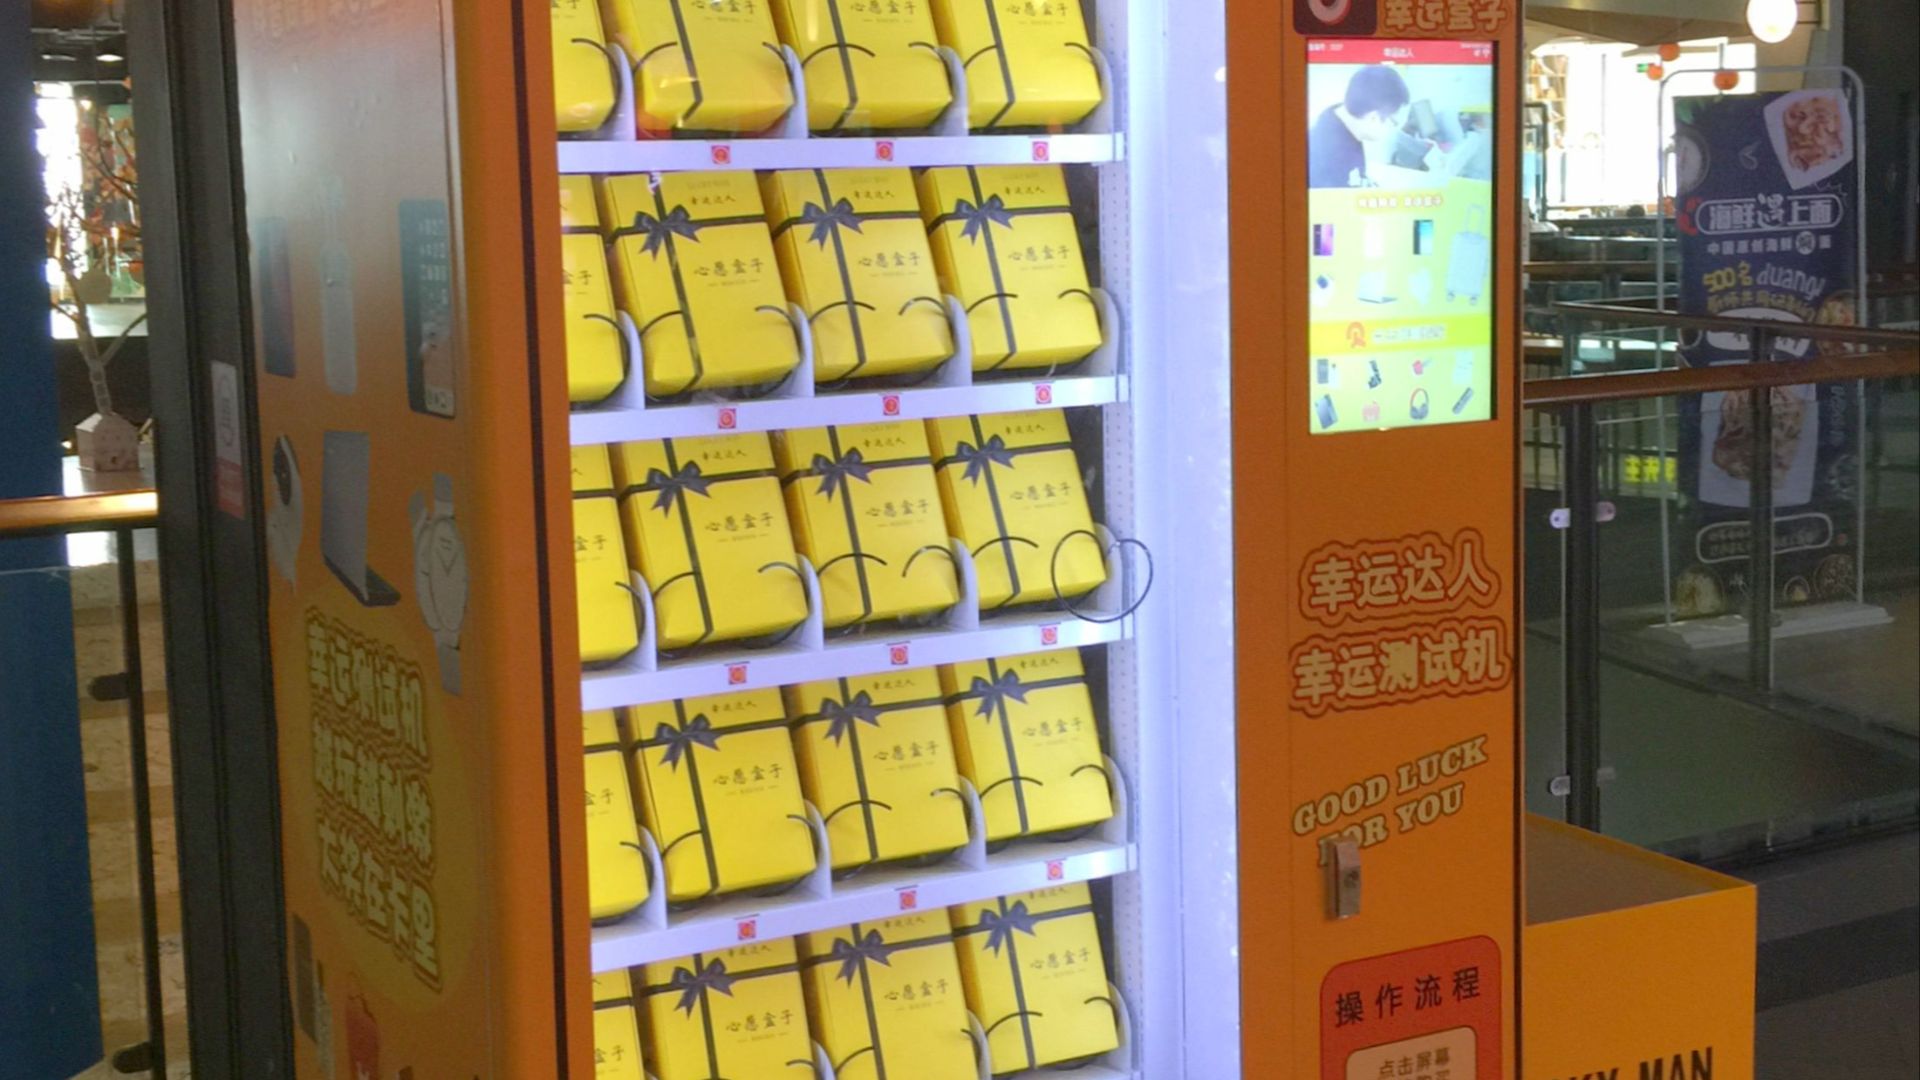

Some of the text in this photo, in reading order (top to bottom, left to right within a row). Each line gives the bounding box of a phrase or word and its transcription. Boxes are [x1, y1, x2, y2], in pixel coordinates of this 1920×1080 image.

[1385, 0, 1506, 30] 幸运盒子
[1309, 541, 1490, 614] 幸运达人
[1294, 628, 1503, 706] 幸运测试机
[1293, 735, 1488, 835] GOOD LUCK
[1396, 781, 1464, 834] YOU
[1335, 966, 1480, 1028] 操作流程
[1379, 1047, 1449, 1079] 点击屏幕
